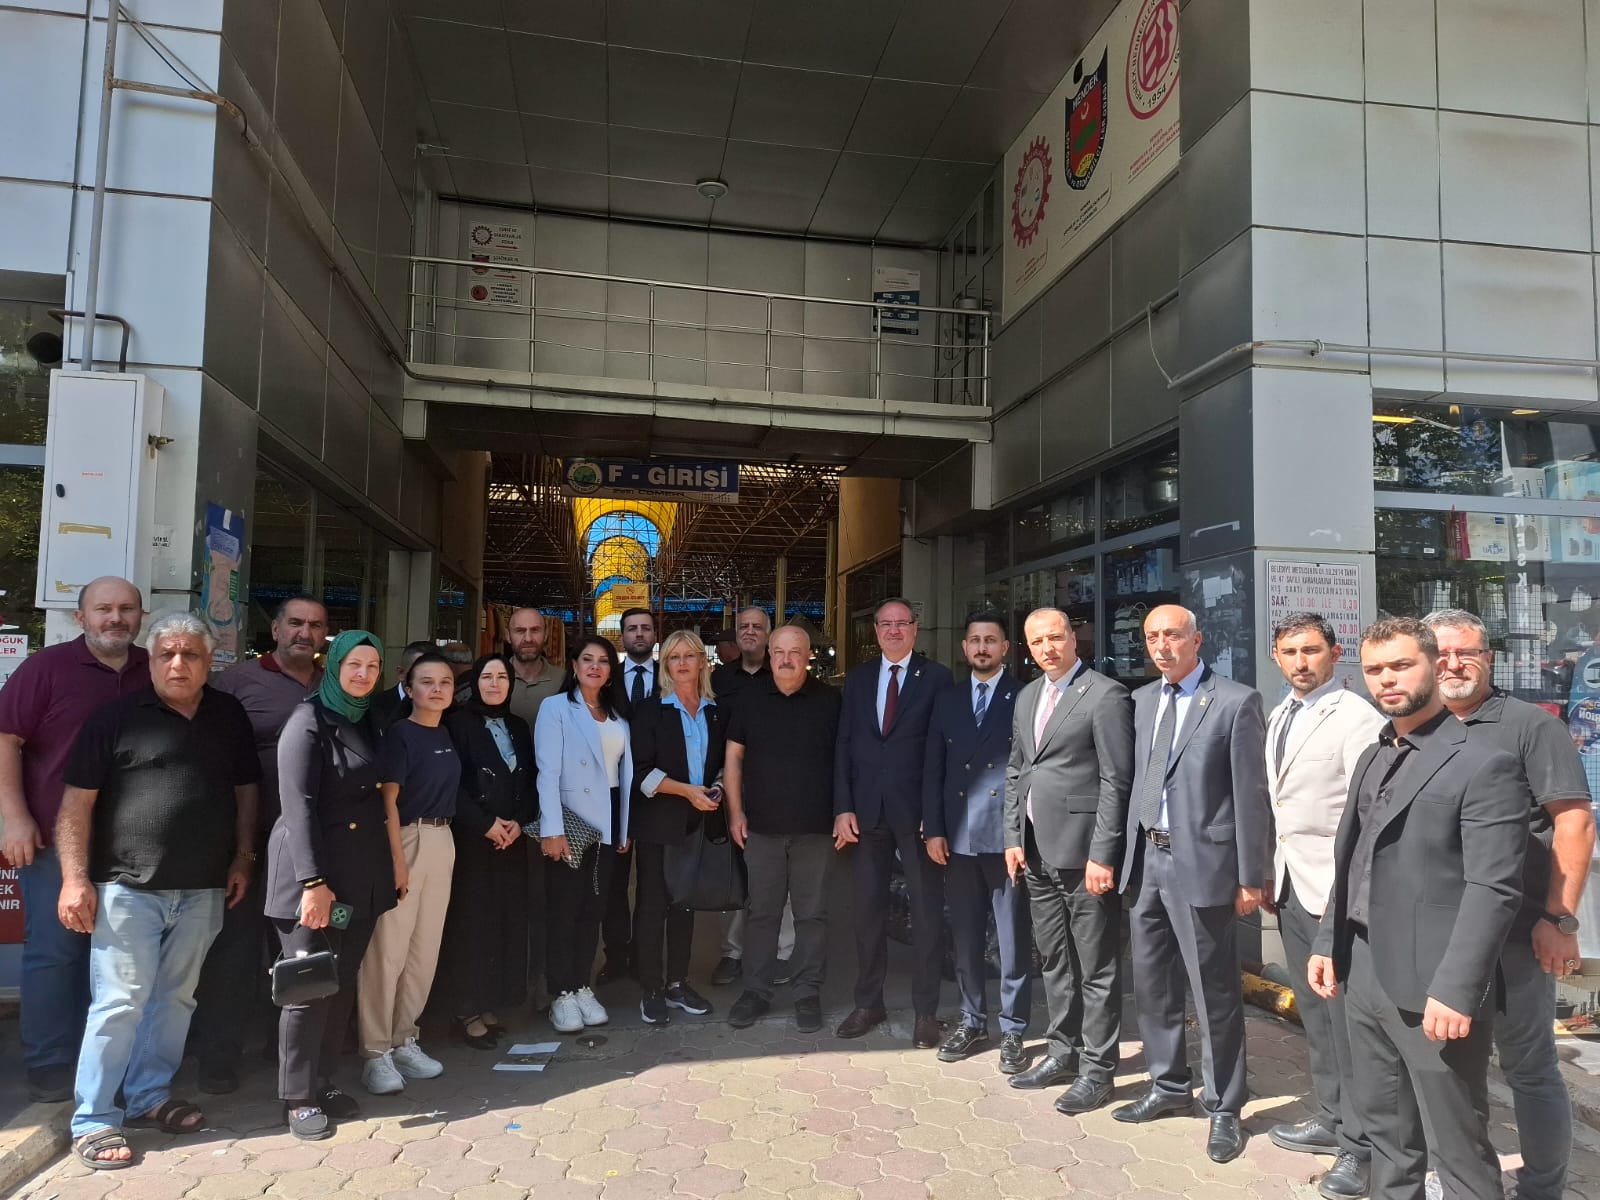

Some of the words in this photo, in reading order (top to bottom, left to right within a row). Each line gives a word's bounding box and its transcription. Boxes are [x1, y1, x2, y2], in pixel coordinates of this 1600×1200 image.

[1073, 71, 1098, 112] HENDEK
[1148, 83, 1166, 109] 1954
[608, 465, 623, 483] F
[648, 464, 729, 491] GİRİŞİ
[1271, 575, 1277, 583] VE
[1271, 584, 1281, 594] KIŞ
[1285, 584, 1303, 593] SAATİ
[1307, 586, 1358, 596] UYGULAMASINDA
[1271, 595, 1290, 607] SAAT:
[1321, 597, 1332, 609] İLE
[1271, 609, 1282, 617] YAZ
[0, 867, 19, 880] Nİ
